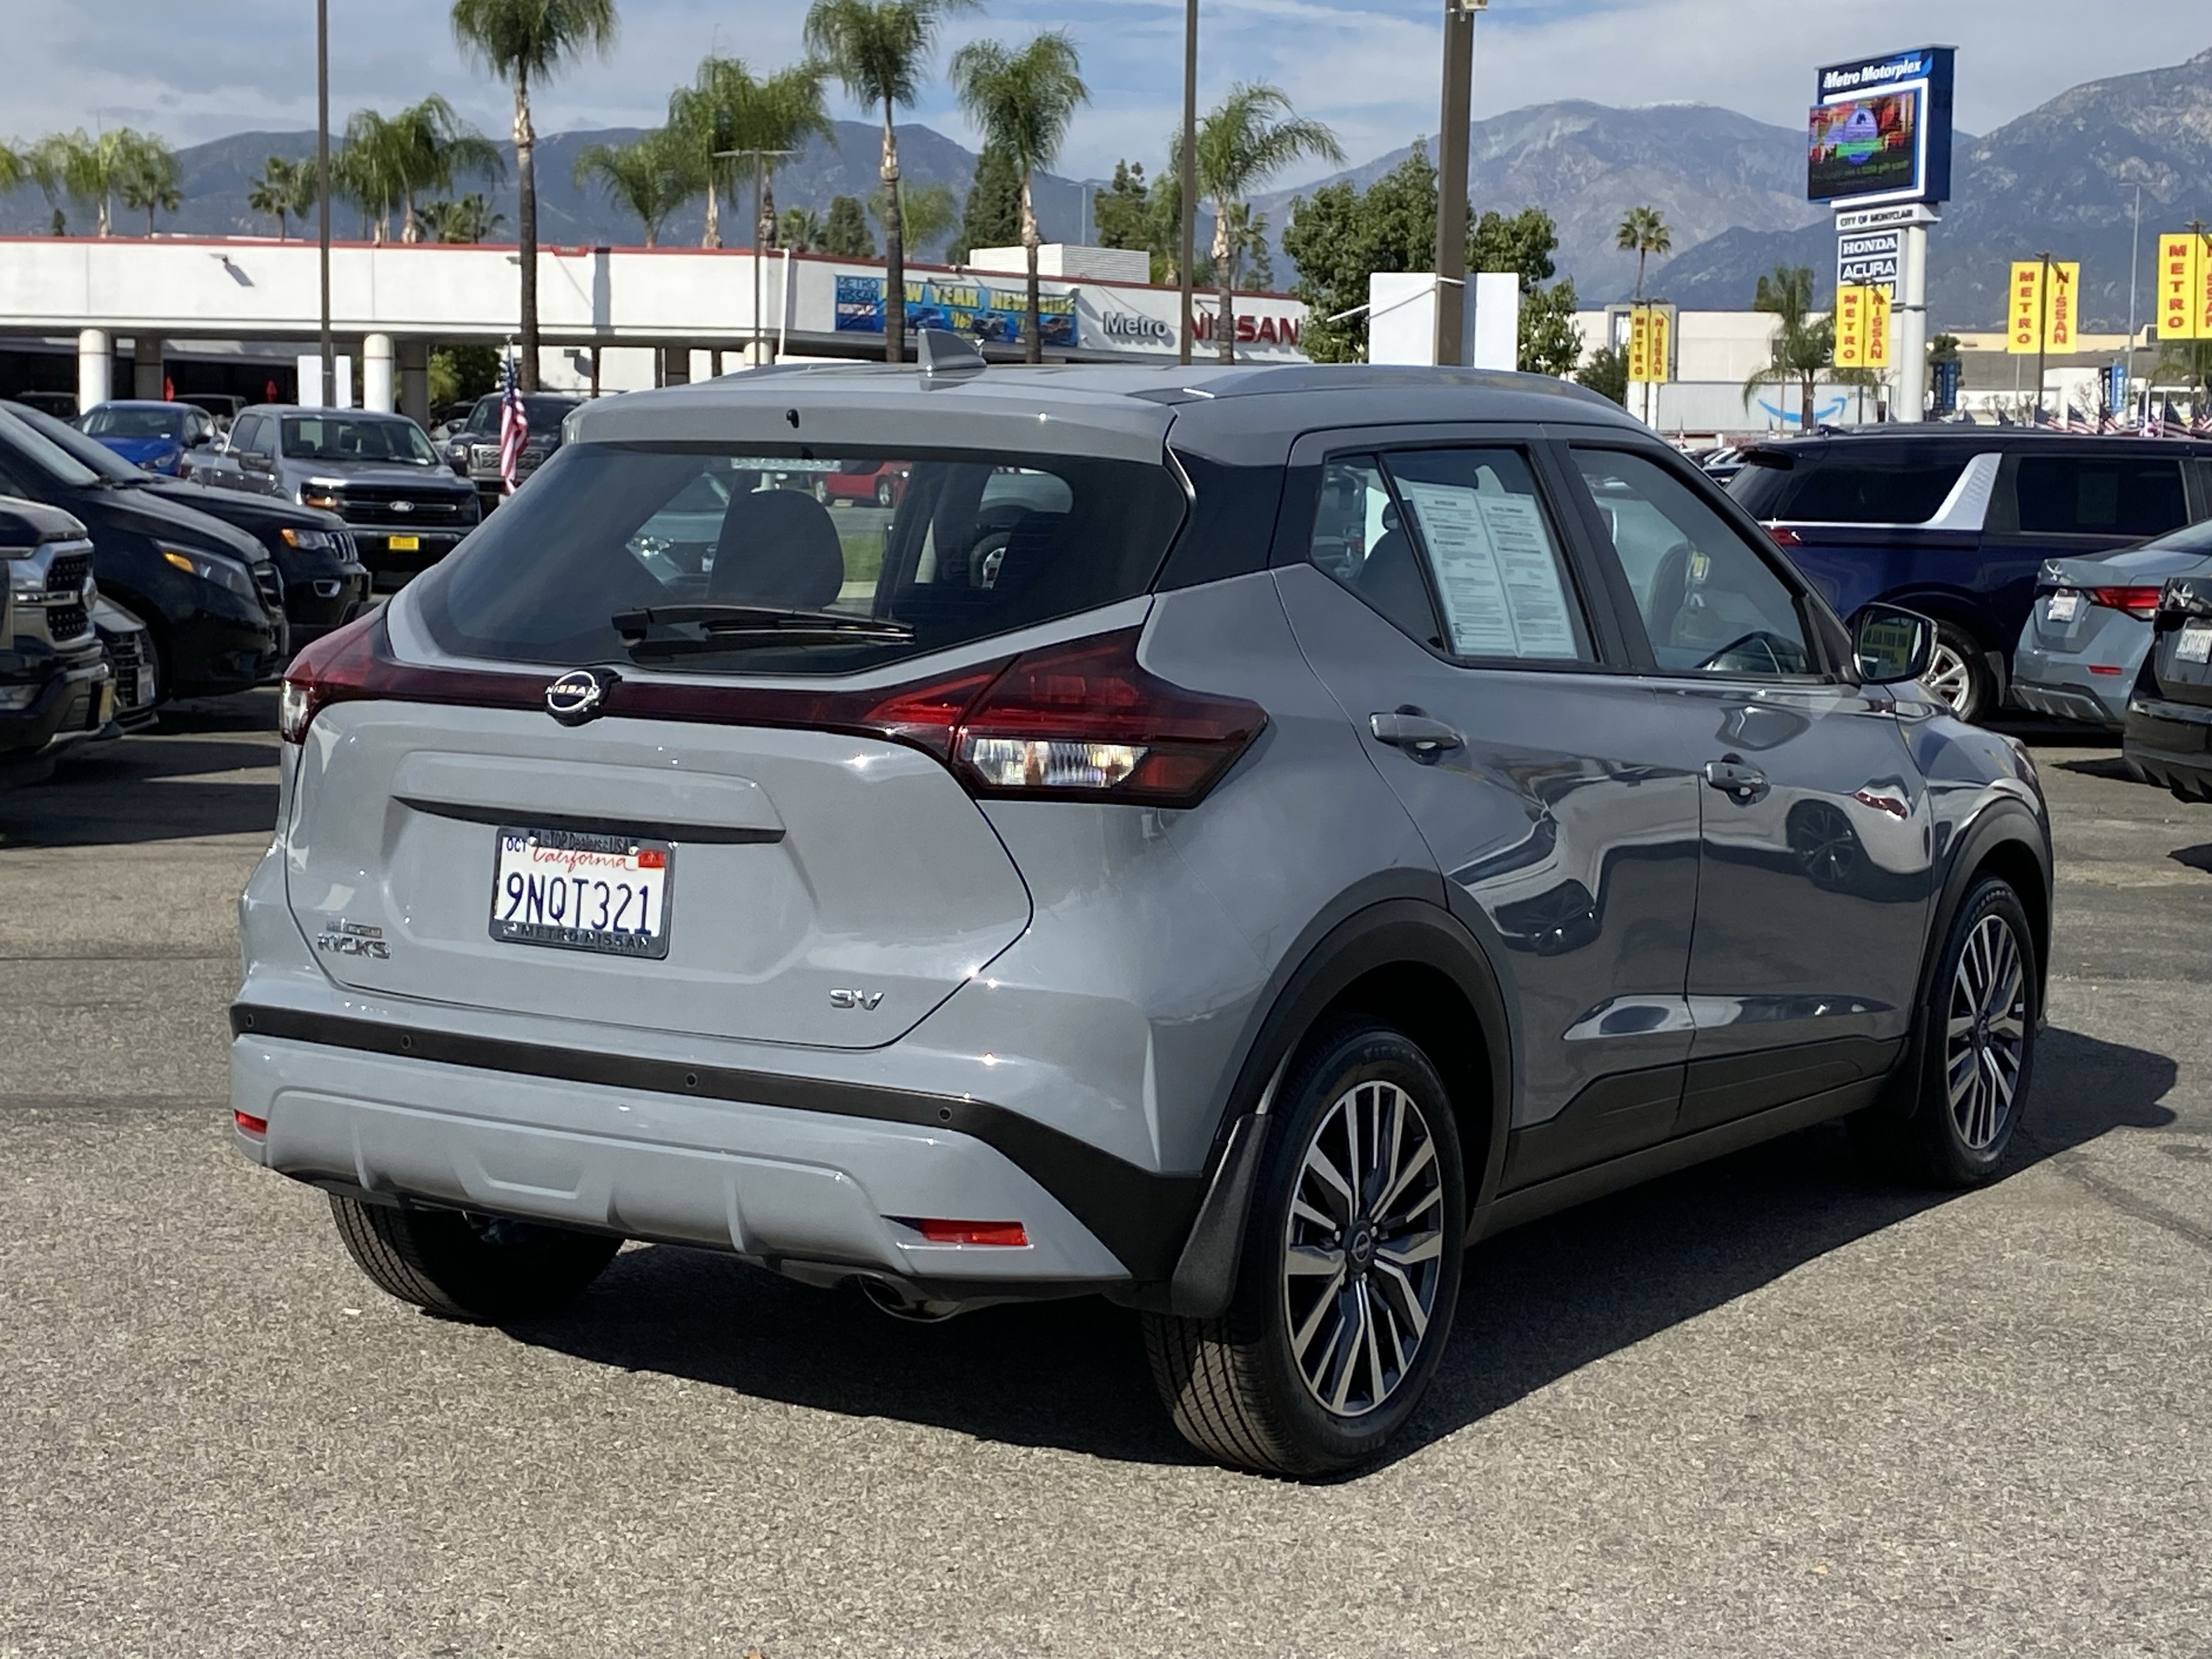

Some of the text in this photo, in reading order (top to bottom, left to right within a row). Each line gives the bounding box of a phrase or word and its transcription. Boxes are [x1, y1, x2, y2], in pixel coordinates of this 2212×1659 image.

[1823, 60, 1921, 88] Metro Motorplex
[1843, 237, 1896, 255] HONDA
[1842, 260, 1895, 279] ACURA
[2169, 244, 2187, 328] METRO
[2017, 272, 2035, 343] METRO
[2053, 272, 2069, 344] NISSAN
[1103, 311, 1298, 346] Metro NISAN
[1843, 295, 1858, 358] METRO
[1871, 295, 1885, 358] NISSAN
[545, 684, 600, 700] NISSAN
[506, 837, 527, 853] OCT
[533, 846, 638, 873] California
[504, 871, 652, 935] 9NQT321
[522, 923, 650, 949] METRO NISSAN
[830, 988, 884, 1011] SV
